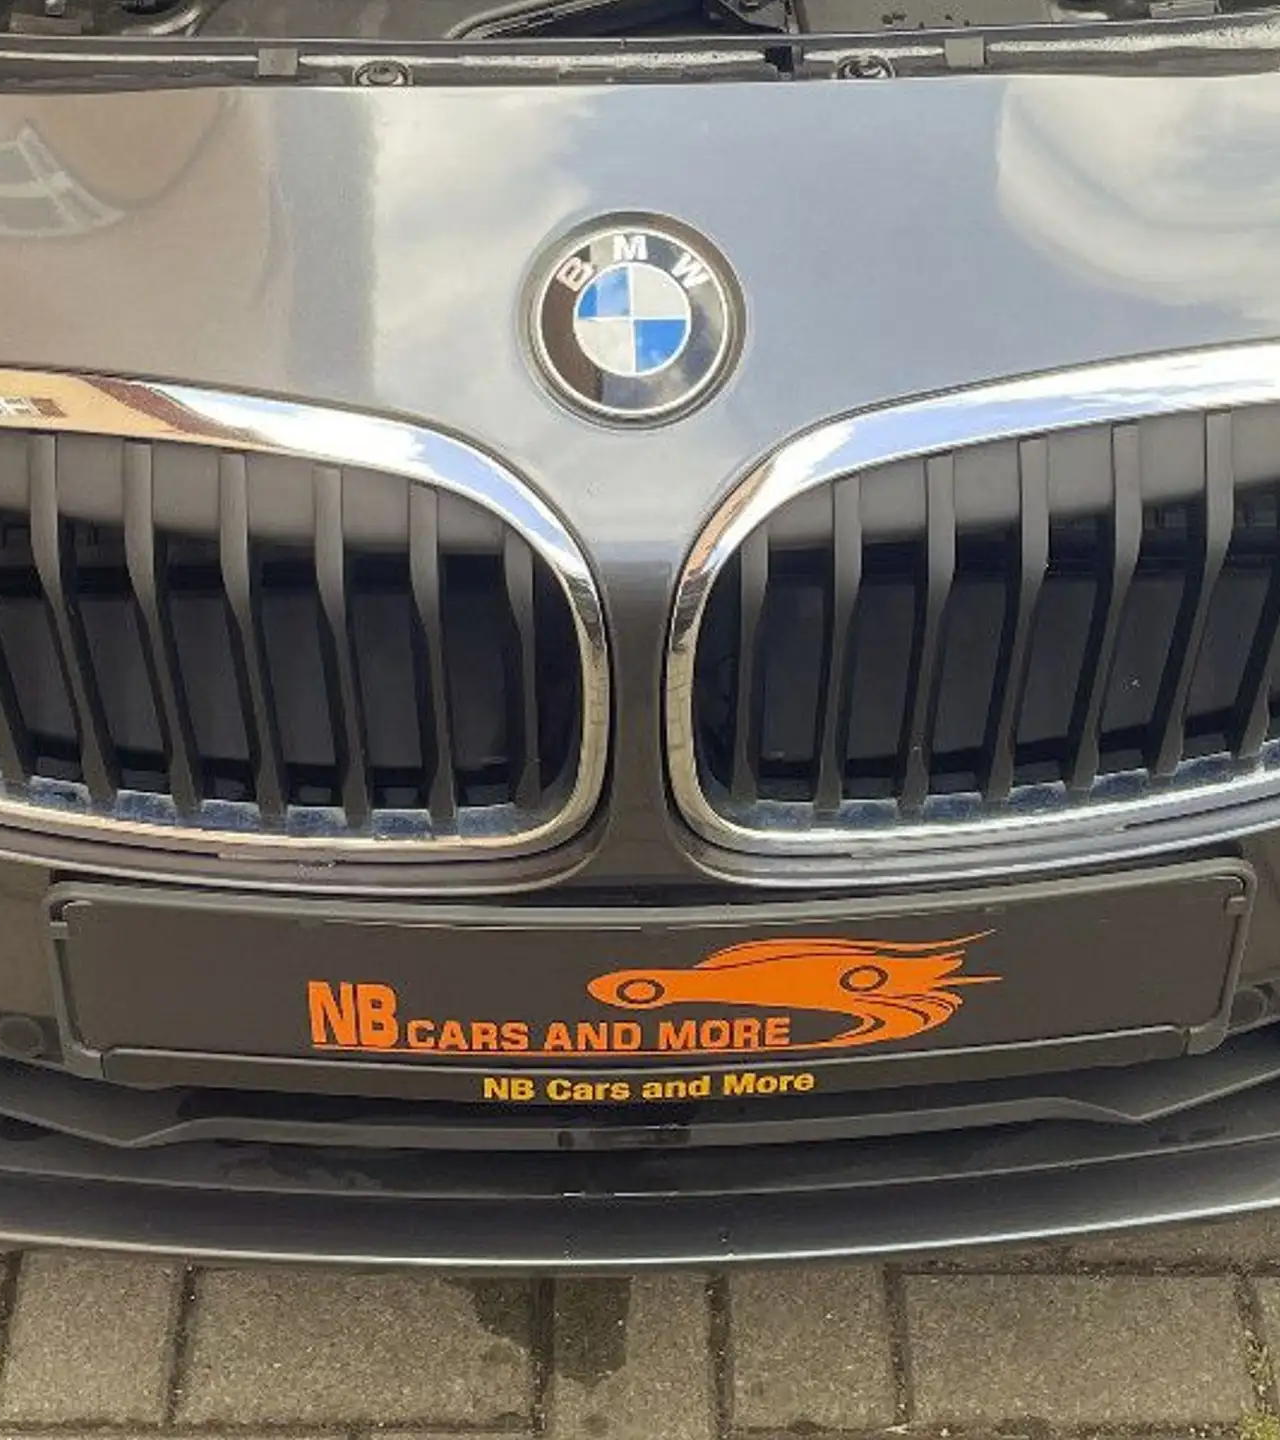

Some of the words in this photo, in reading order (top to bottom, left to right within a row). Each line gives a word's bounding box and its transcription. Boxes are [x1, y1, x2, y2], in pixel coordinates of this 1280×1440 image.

[555, 234, 709, 292] BMW
[307, 980, 399, 1048] NB
[407, 1019, 529, 1051] CARS
[542, 1020, 642, 1051] AND
[658, 1016, 791, 1050] MORE
[483, 1077, 535, 1101] NB
[546, 1078, 631, 1101] Cars
[641, 1074, 712, 1099] and
[722, 1071, 815, 1096] More
